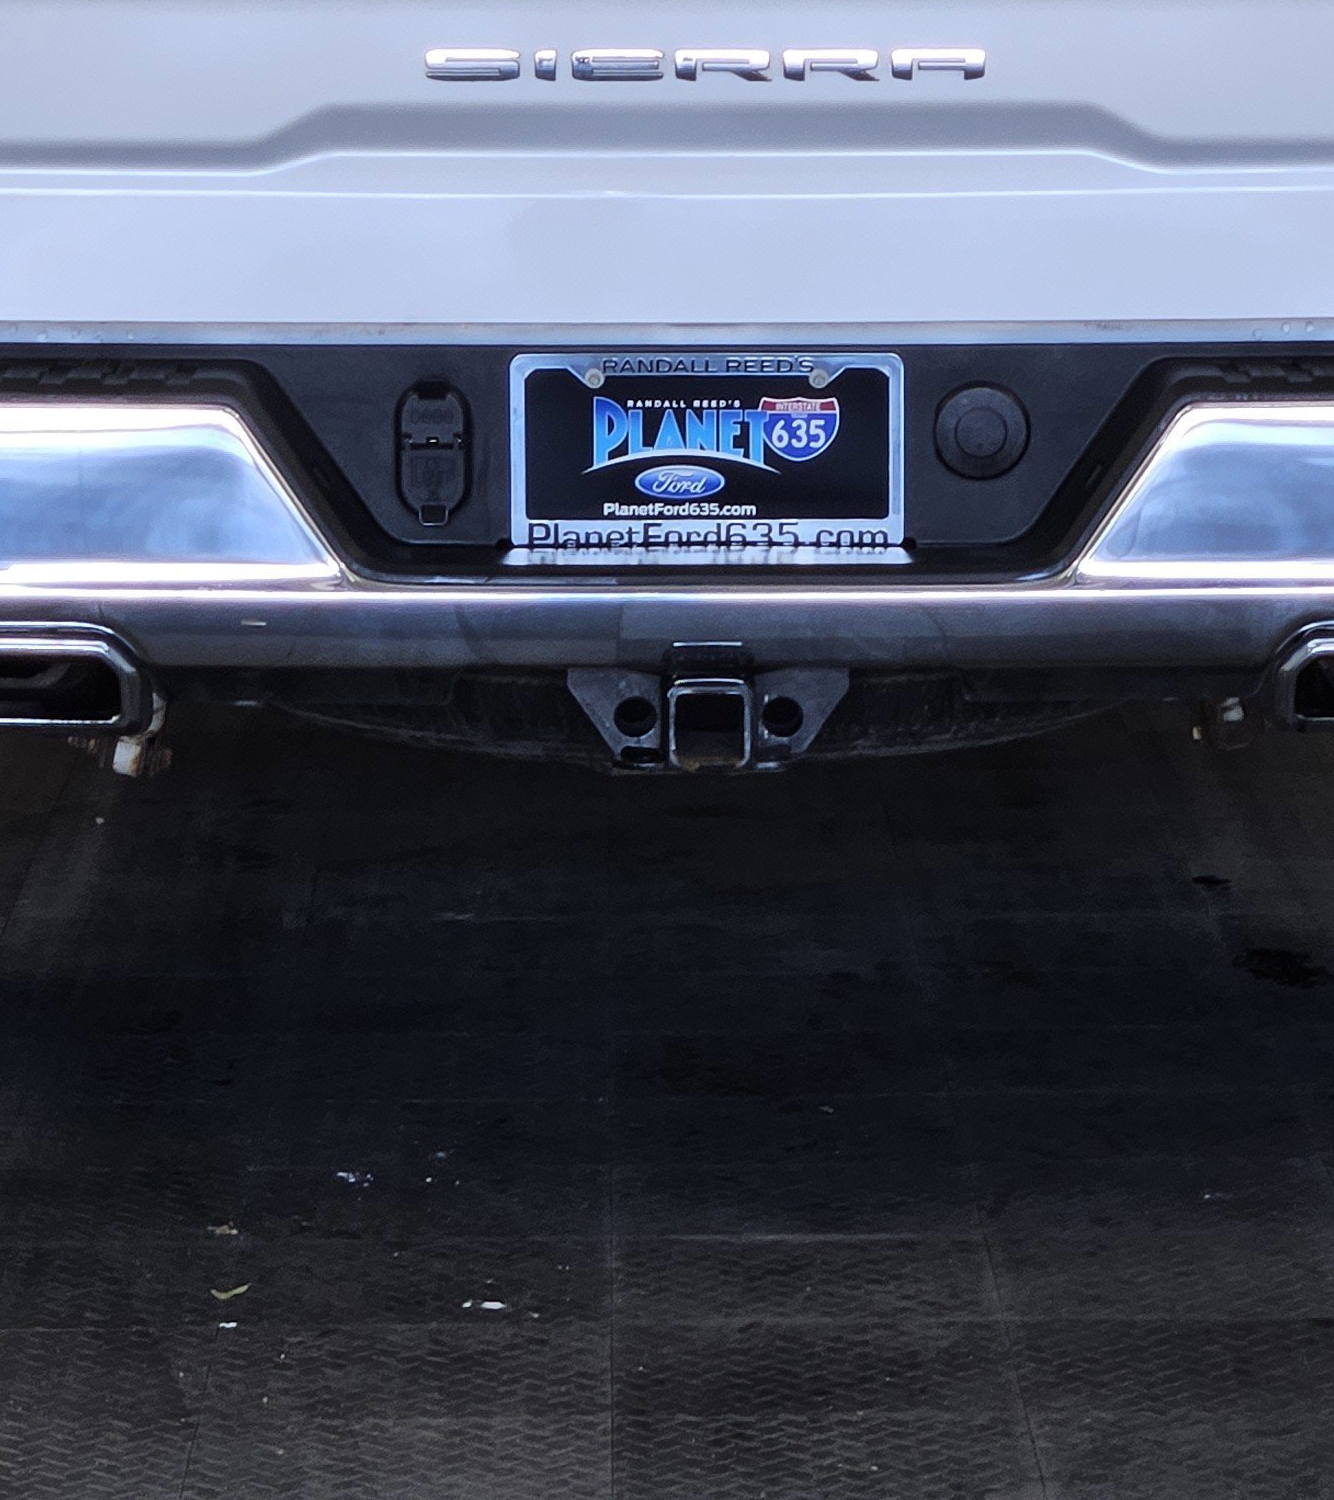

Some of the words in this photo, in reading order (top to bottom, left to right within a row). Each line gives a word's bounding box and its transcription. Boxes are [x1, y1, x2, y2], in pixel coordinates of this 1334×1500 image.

[424, 47, 986, 81] SIERRA
[602, 356, 717, 374] RANDALL
[725, 354, 815, 374] REED'S
[627, 399, 687, 409] RANDALL
[693, 399, 741, 408] REED'S
[775, 402, 821, 411] INTERSTATE
[592, 397, 770, 466] PLANET
[772, 419, 826, 449] 635
[652, 470, 706, 494] Ford
[603, 502, 756, 516] PlanetFord635.com
[527, 522, 889, 547] PlanetFord635.com
